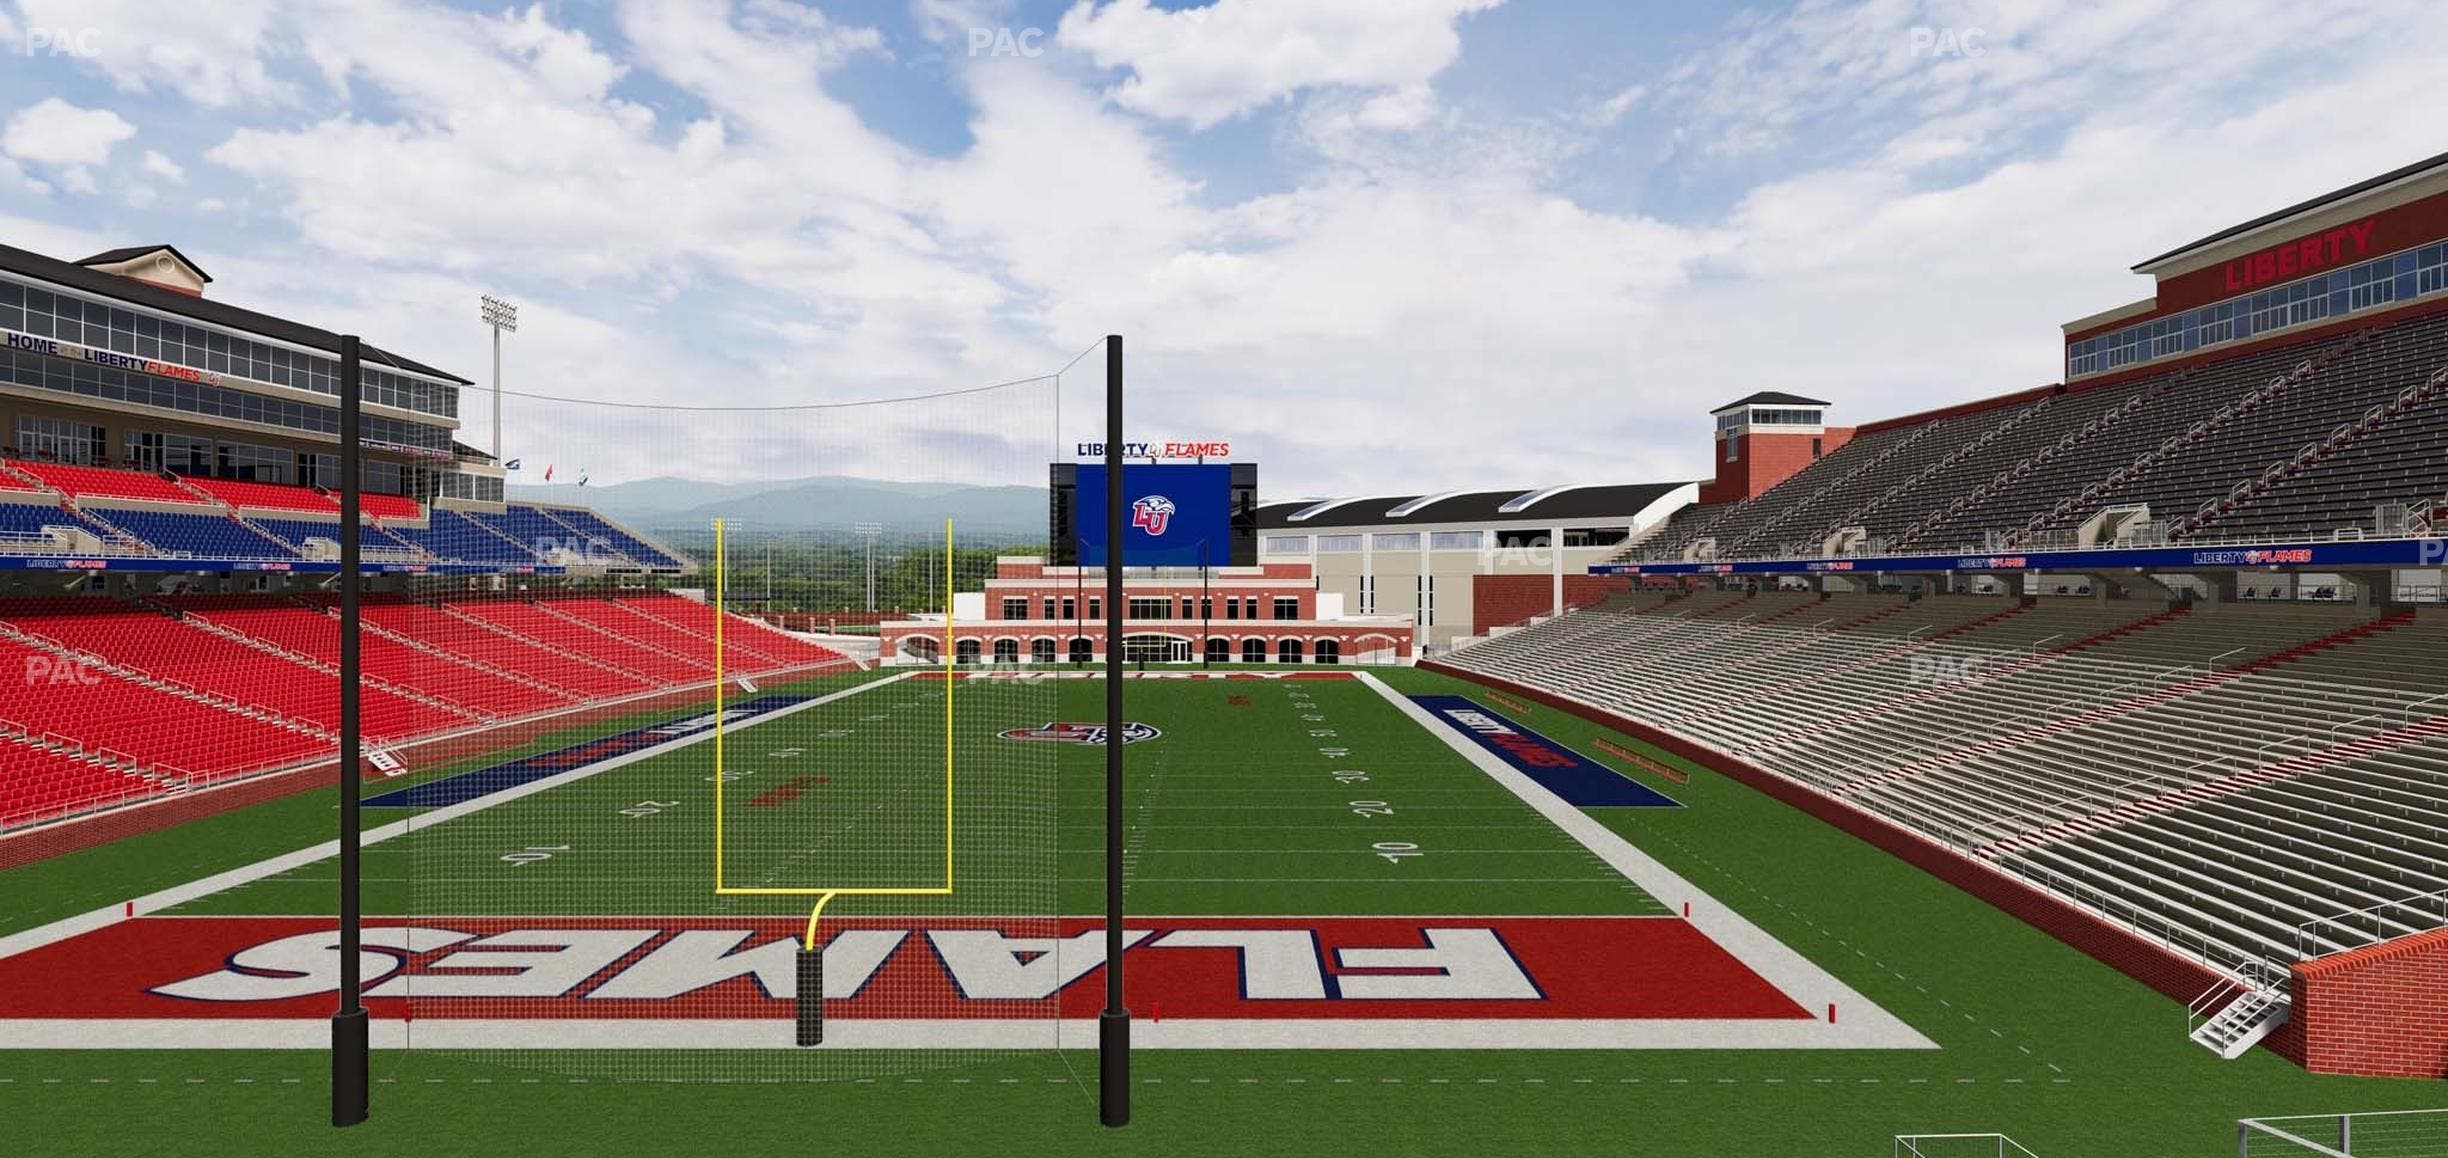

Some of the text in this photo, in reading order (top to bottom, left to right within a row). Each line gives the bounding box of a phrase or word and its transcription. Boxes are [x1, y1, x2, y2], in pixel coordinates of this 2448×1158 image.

[2224, 219, 2377, 291] LIBERTY
[7, 332, 58, 355] HOME
[1078, 443, 1149, 456] LIBTY
[1164, 443, 1230, 456] FLAMES
[2194, 549, 2312, 564] LIBERTY FLAMES
[1348, 800, 1395, 815] 20
[500, 844, 570, 862] 10
[1372, 841, 1424, 858] 10
[141, 926, 1544, 1003] FLAMES
